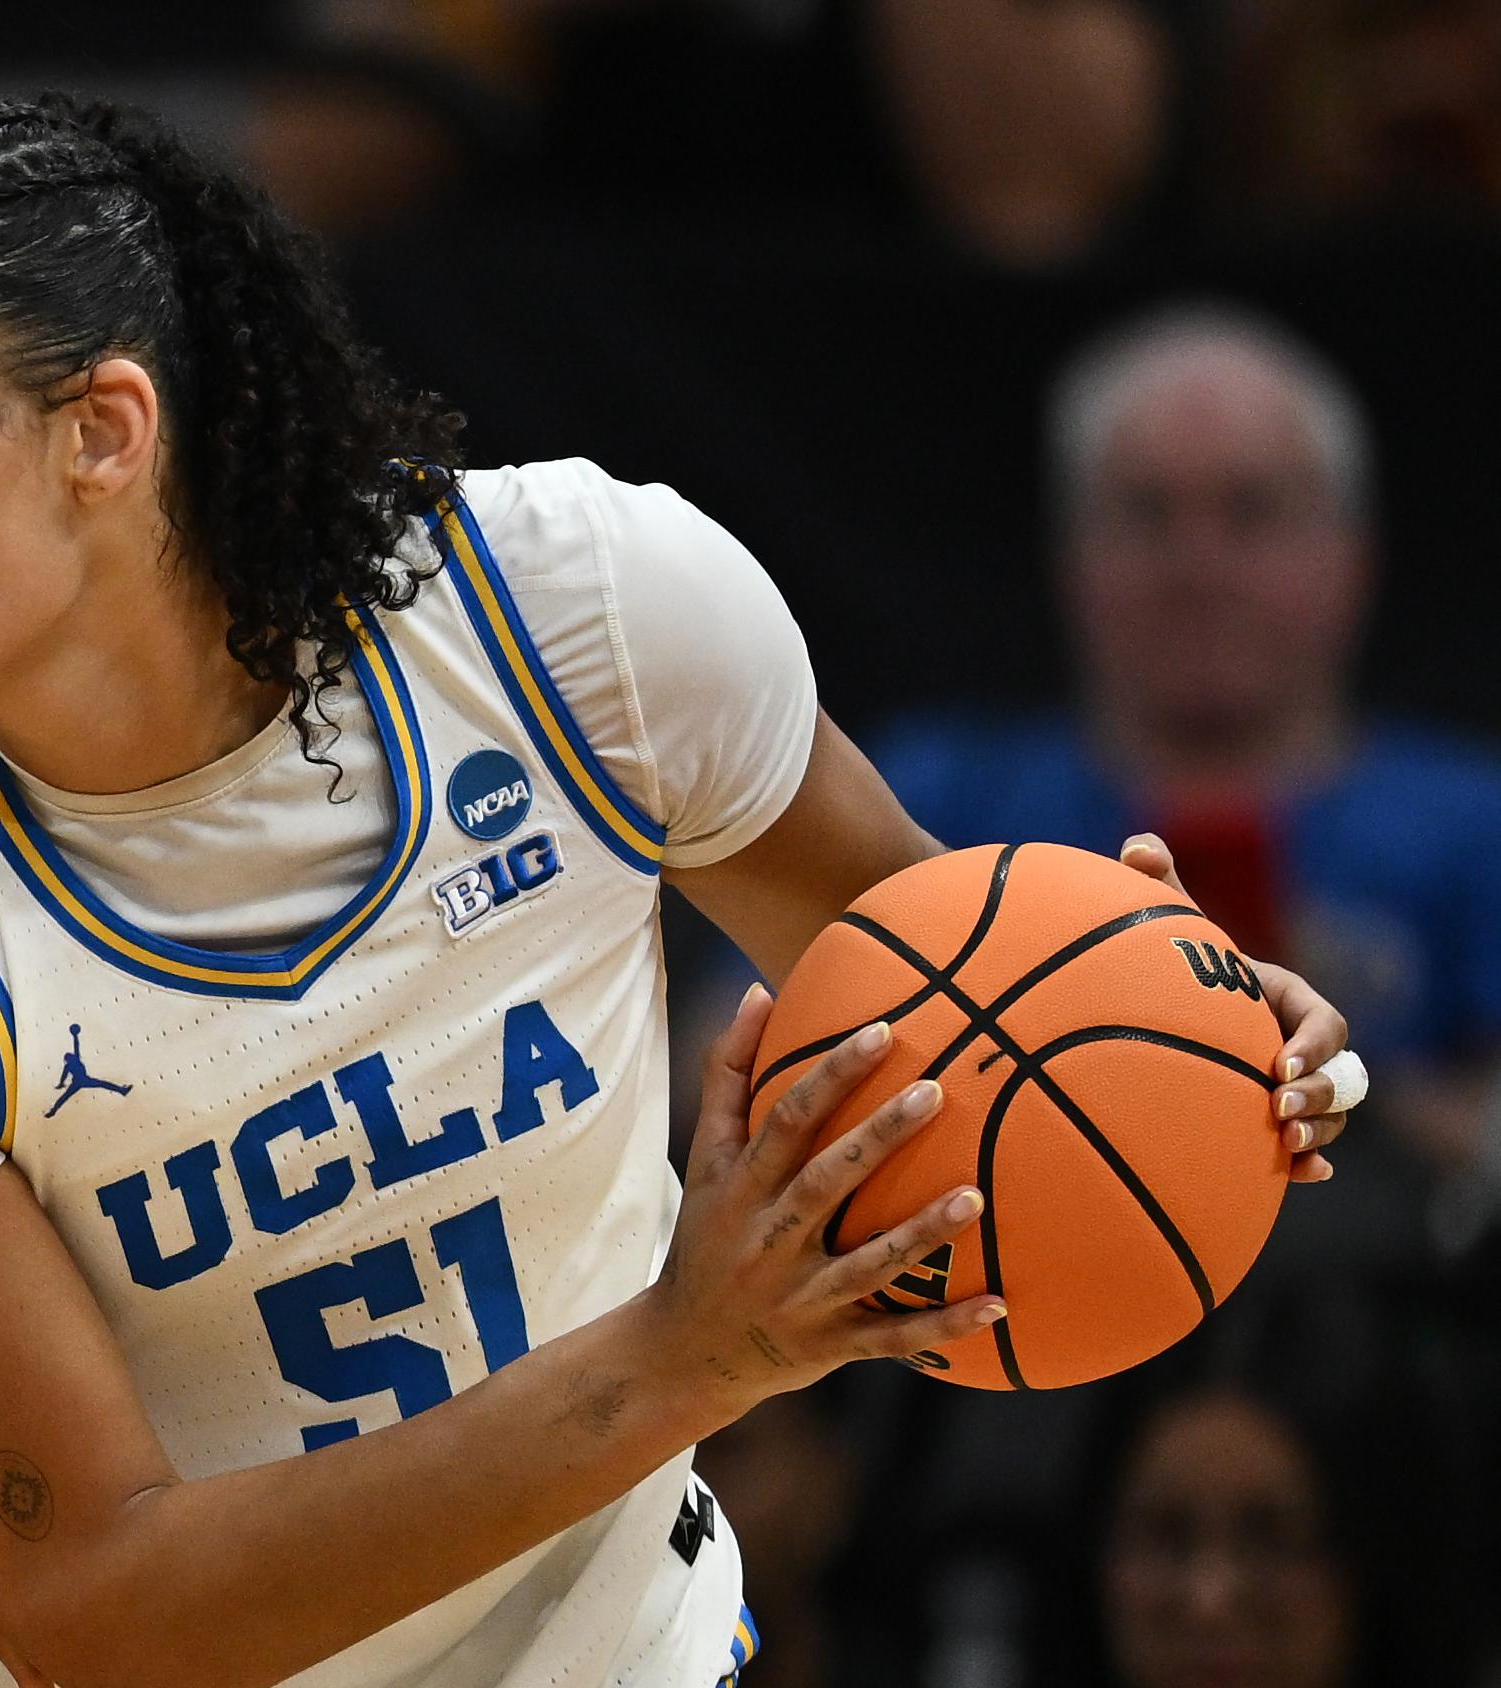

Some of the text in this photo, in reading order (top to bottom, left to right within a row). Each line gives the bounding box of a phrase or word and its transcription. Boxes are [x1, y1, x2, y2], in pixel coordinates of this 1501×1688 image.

[464, 780, 529, 827] NCAA
[96, 1000, 599, 1290] UCLA
[254, 1196, 530, 1453] 51
